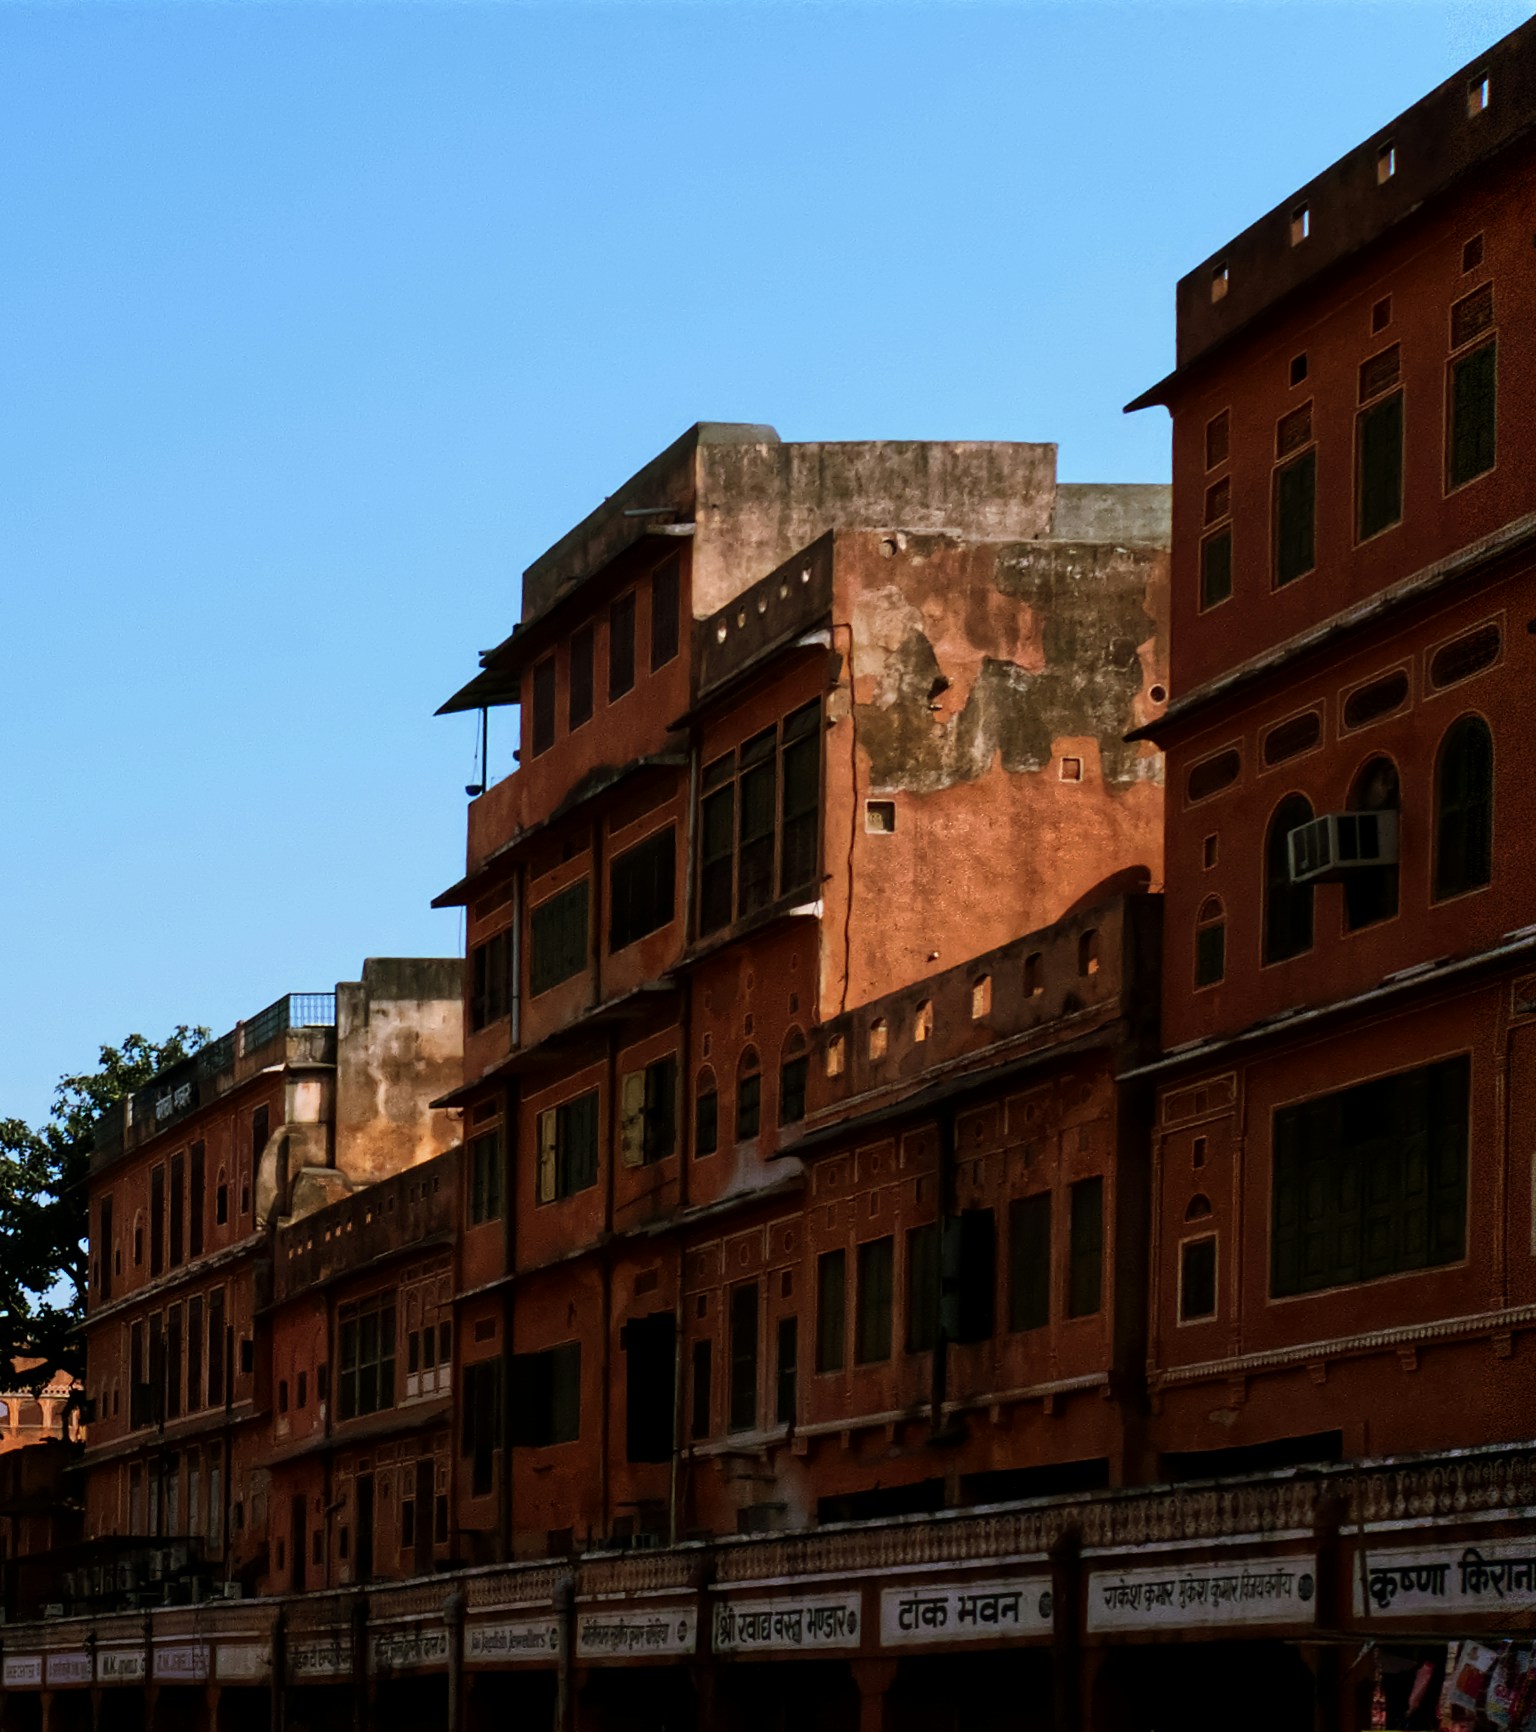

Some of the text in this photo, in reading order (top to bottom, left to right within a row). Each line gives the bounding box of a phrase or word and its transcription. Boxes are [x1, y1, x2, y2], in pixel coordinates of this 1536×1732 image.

[1103, 1578, 1143, 1611] राकेश
[1144, 1581, 1176, 1612] कुमार
[1211, 1576, 1240, 1608] कुमार
[1370, 1563, 1451, 1609] कृष्णा
[899, 1591, 1023, 1630] टांक भवन
